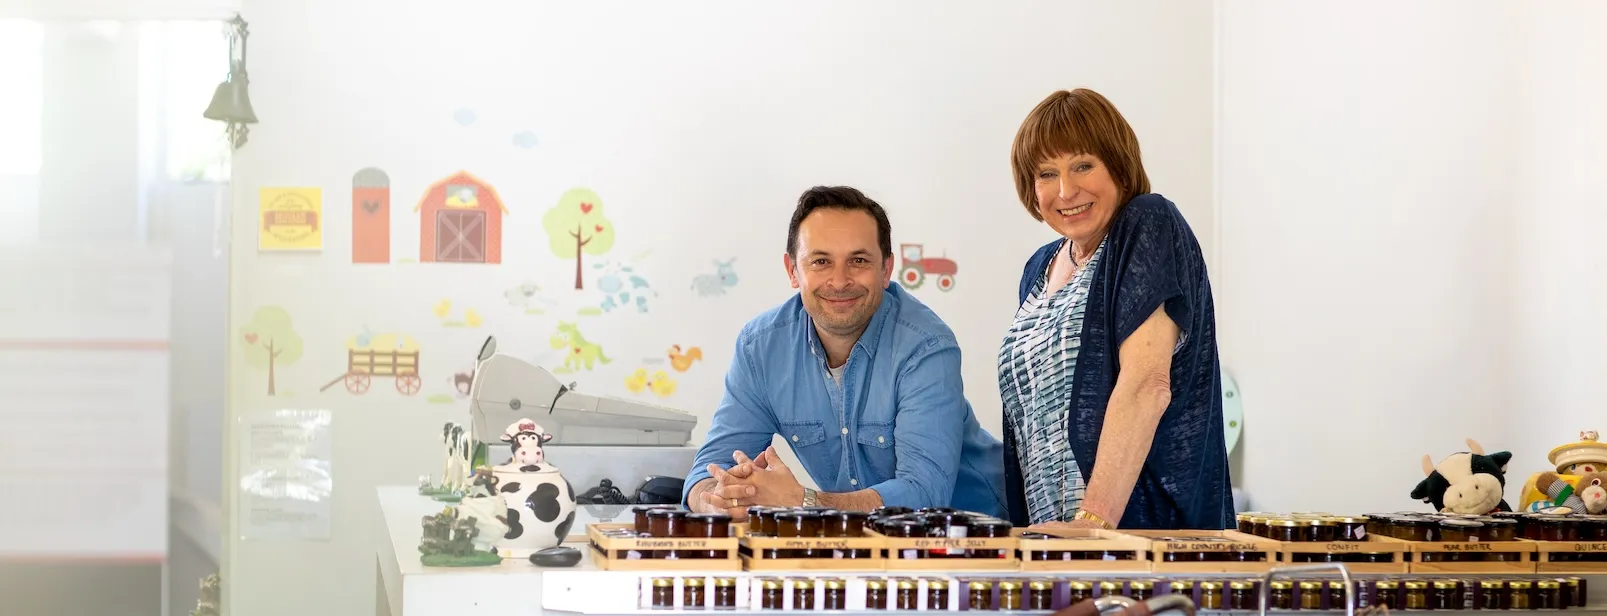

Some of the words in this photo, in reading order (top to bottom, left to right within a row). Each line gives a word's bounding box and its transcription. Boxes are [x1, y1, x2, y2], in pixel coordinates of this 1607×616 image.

[1167, 543, 1188, 551] HIGH
[1326, 543, 1359, 551] CONFIT
[1443, 543, 1462, 551] PEAR
[1464, 543, 1492, 551] BUTTER
[1574, 543, 1607, 552] QUINCE
